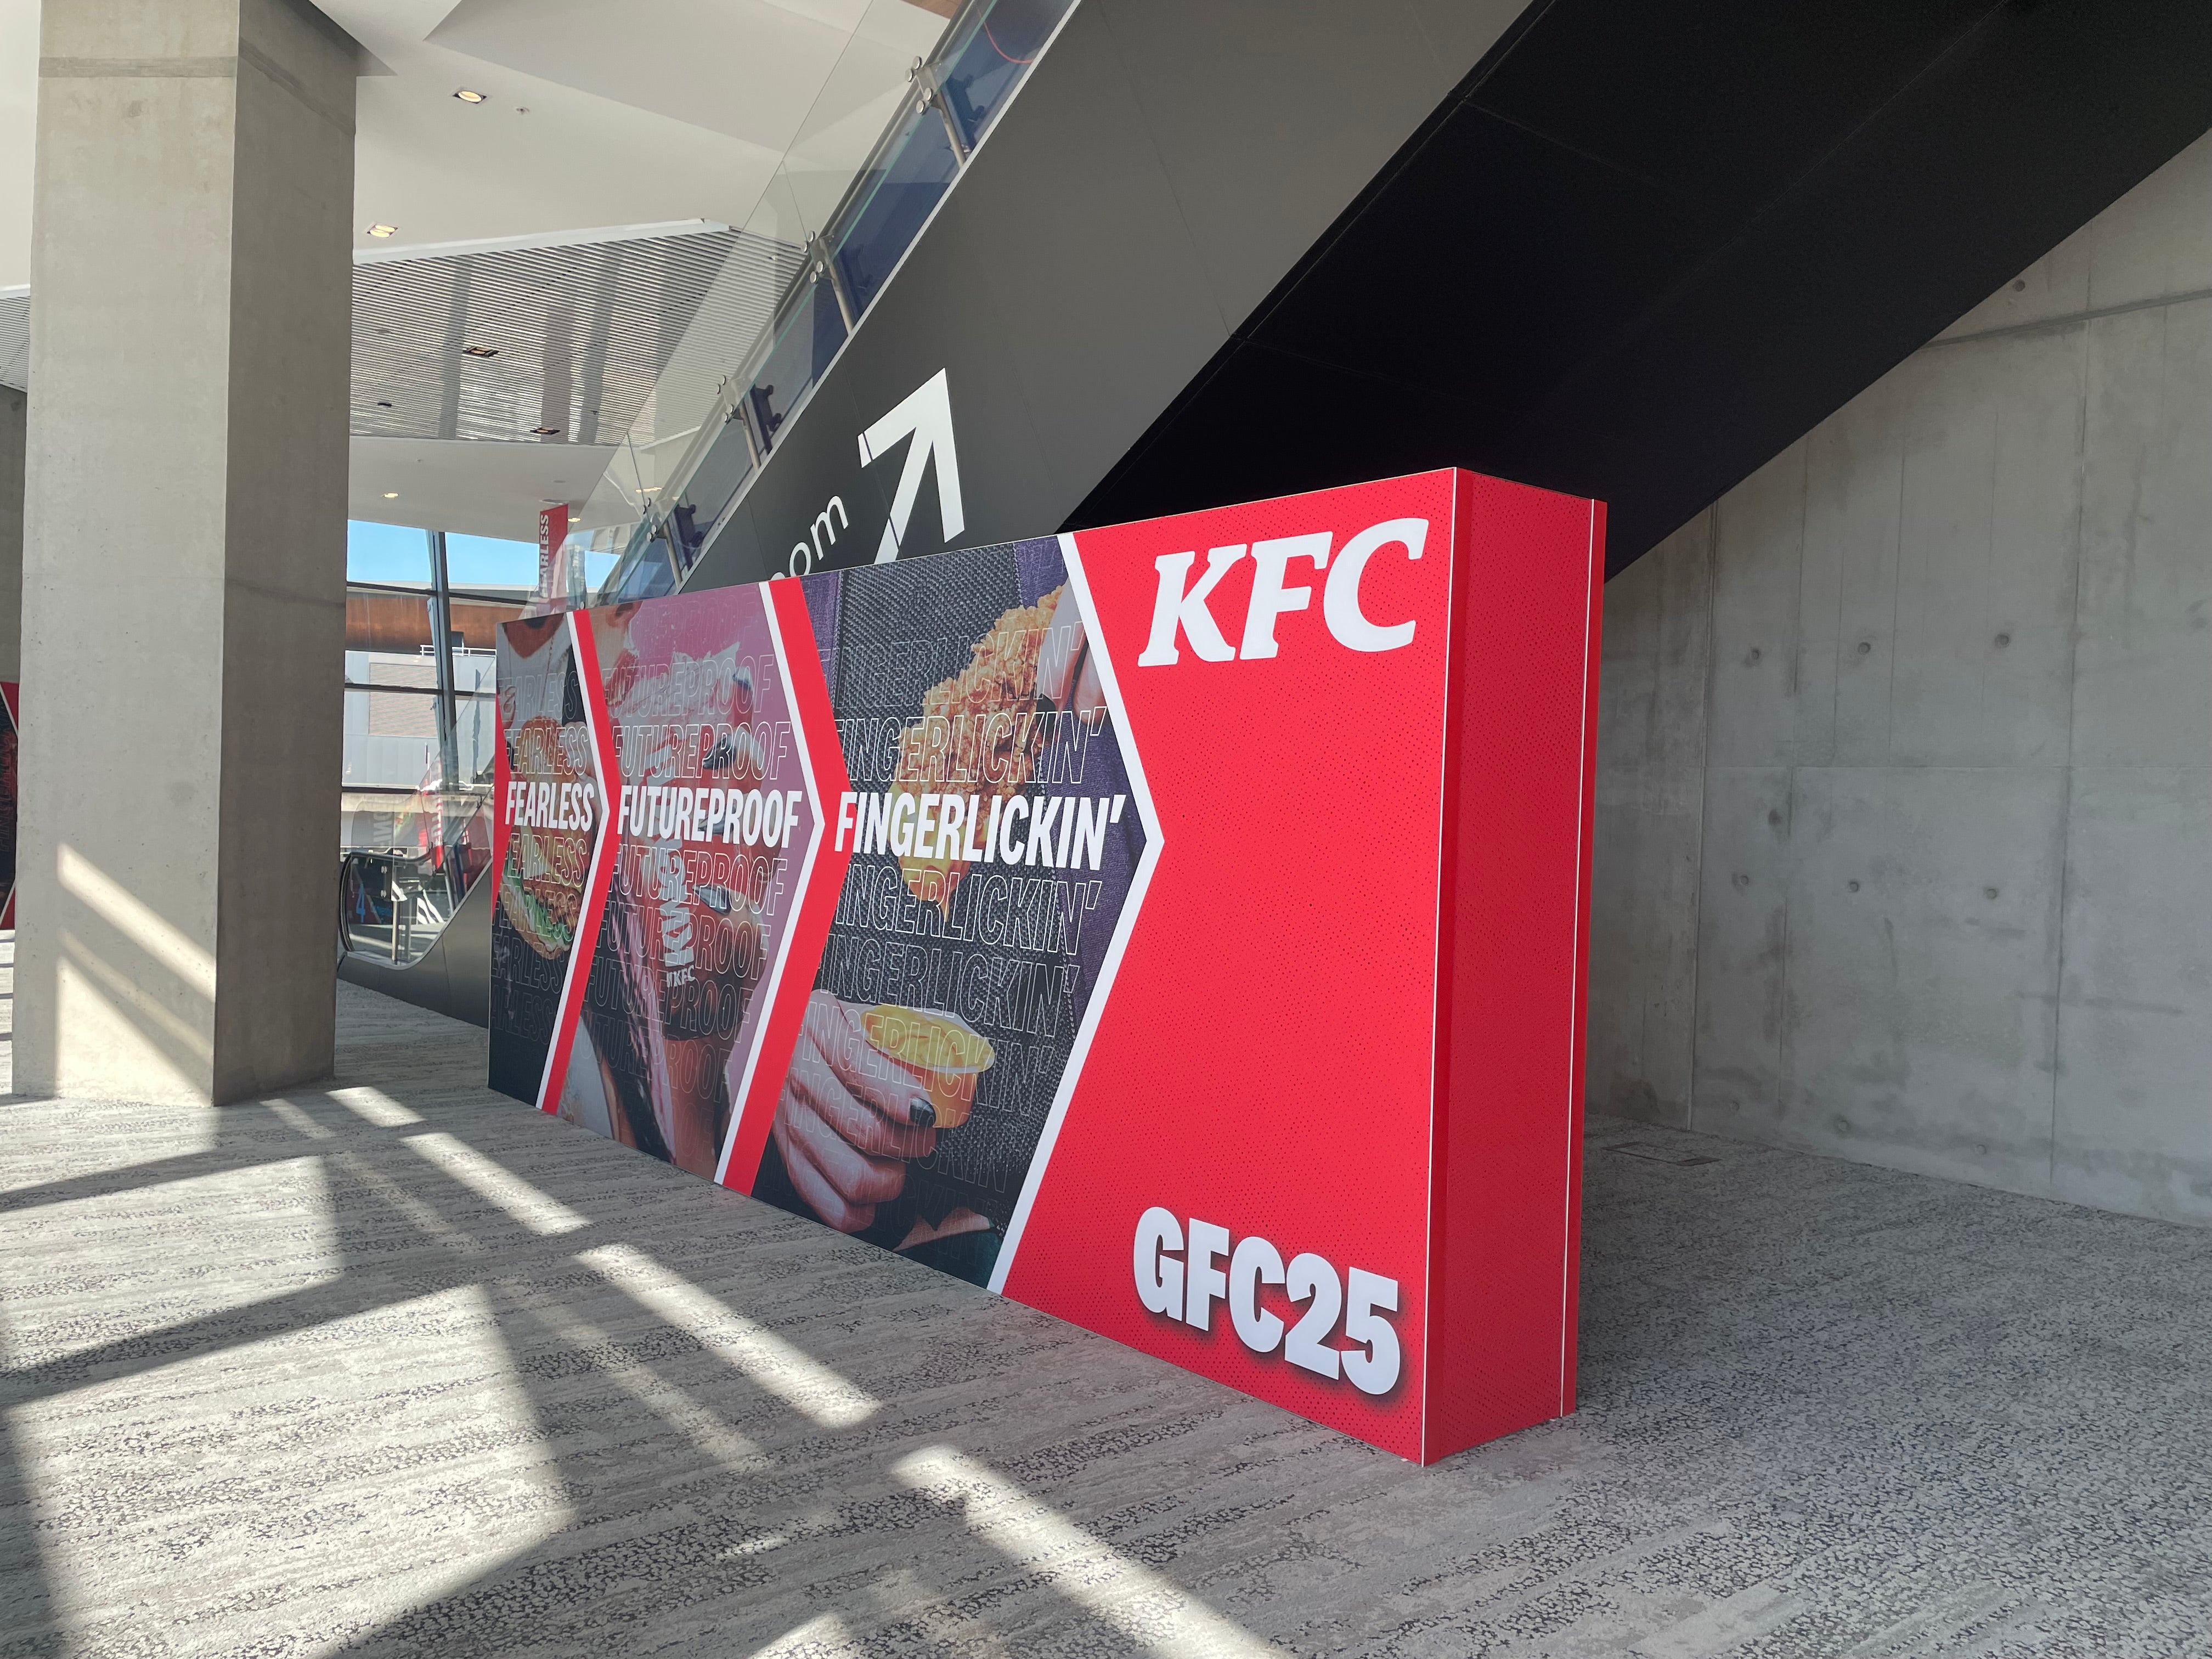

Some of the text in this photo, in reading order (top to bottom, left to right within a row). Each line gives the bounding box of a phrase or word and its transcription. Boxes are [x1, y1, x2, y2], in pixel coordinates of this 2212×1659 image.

[771, 495, 848, 580] om
[1137, 517, 1429, 667] KFC
[612, 721, 791, 780] FUTUREPROOF
[505, 781, 595, 832] FEARLESS
[617, 785, 802, 849] FUTUREPROOF
[834, 791, 1126, 871] FINGERLICKIN'
[505, 833, 587, 888] EARLESS
[818, 933, 1080, 1038] INGERLICKIN'
[577, 1011, 733, 1103] UTUREPROOF
[799, 1001, 1055, 1117] INGERLICKIN'
[1133, 1206, 1400, 1395] GFC25
